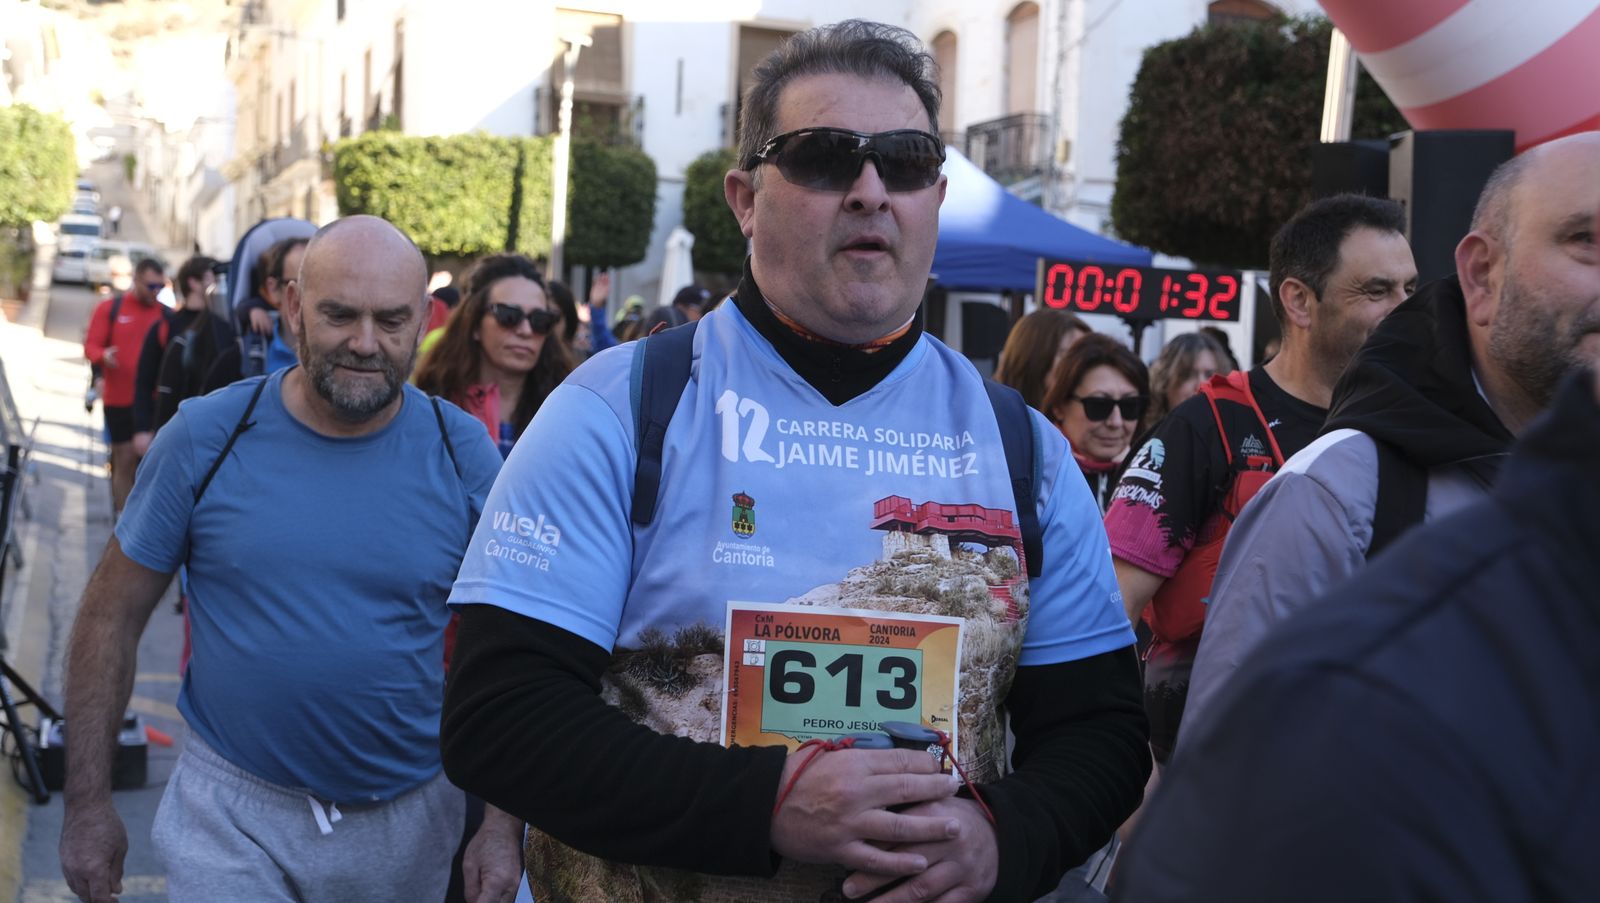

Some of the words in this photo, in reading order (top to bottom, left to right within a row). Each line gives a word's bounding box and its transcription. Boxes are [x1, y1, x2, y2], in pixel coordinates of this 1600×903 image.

[715, 389, 775, 463] 12
[776, 418, 869, 441] CARRERA
[874, 427, 975, 450] SOLIDARIA
[774, 441, 859, 469] JAIME
[865, 449, 979, 478] JIMÉNEZ
[492, 511, 561, 547] vuela
[485, 539, 549, 571] Cantoria
[507, 535, 557, 556] GUADALINFO
[716, 541, 761, 552] Ayuntamiento
[712, 549, 774, 567] Cantoria
[755, 614, 774, 624] CxM
[754, 624, 771, 637] LA
[775, 622, 841, 641] PÓLVORA
[869, 635, 890, 645] 2024
[870, 624, 916, 637] CANTORIA
[769, 649, 918, 710] 613
[803, 718, 844, 729] PEDRO
[847, 720, 883, 731] JESÚS
